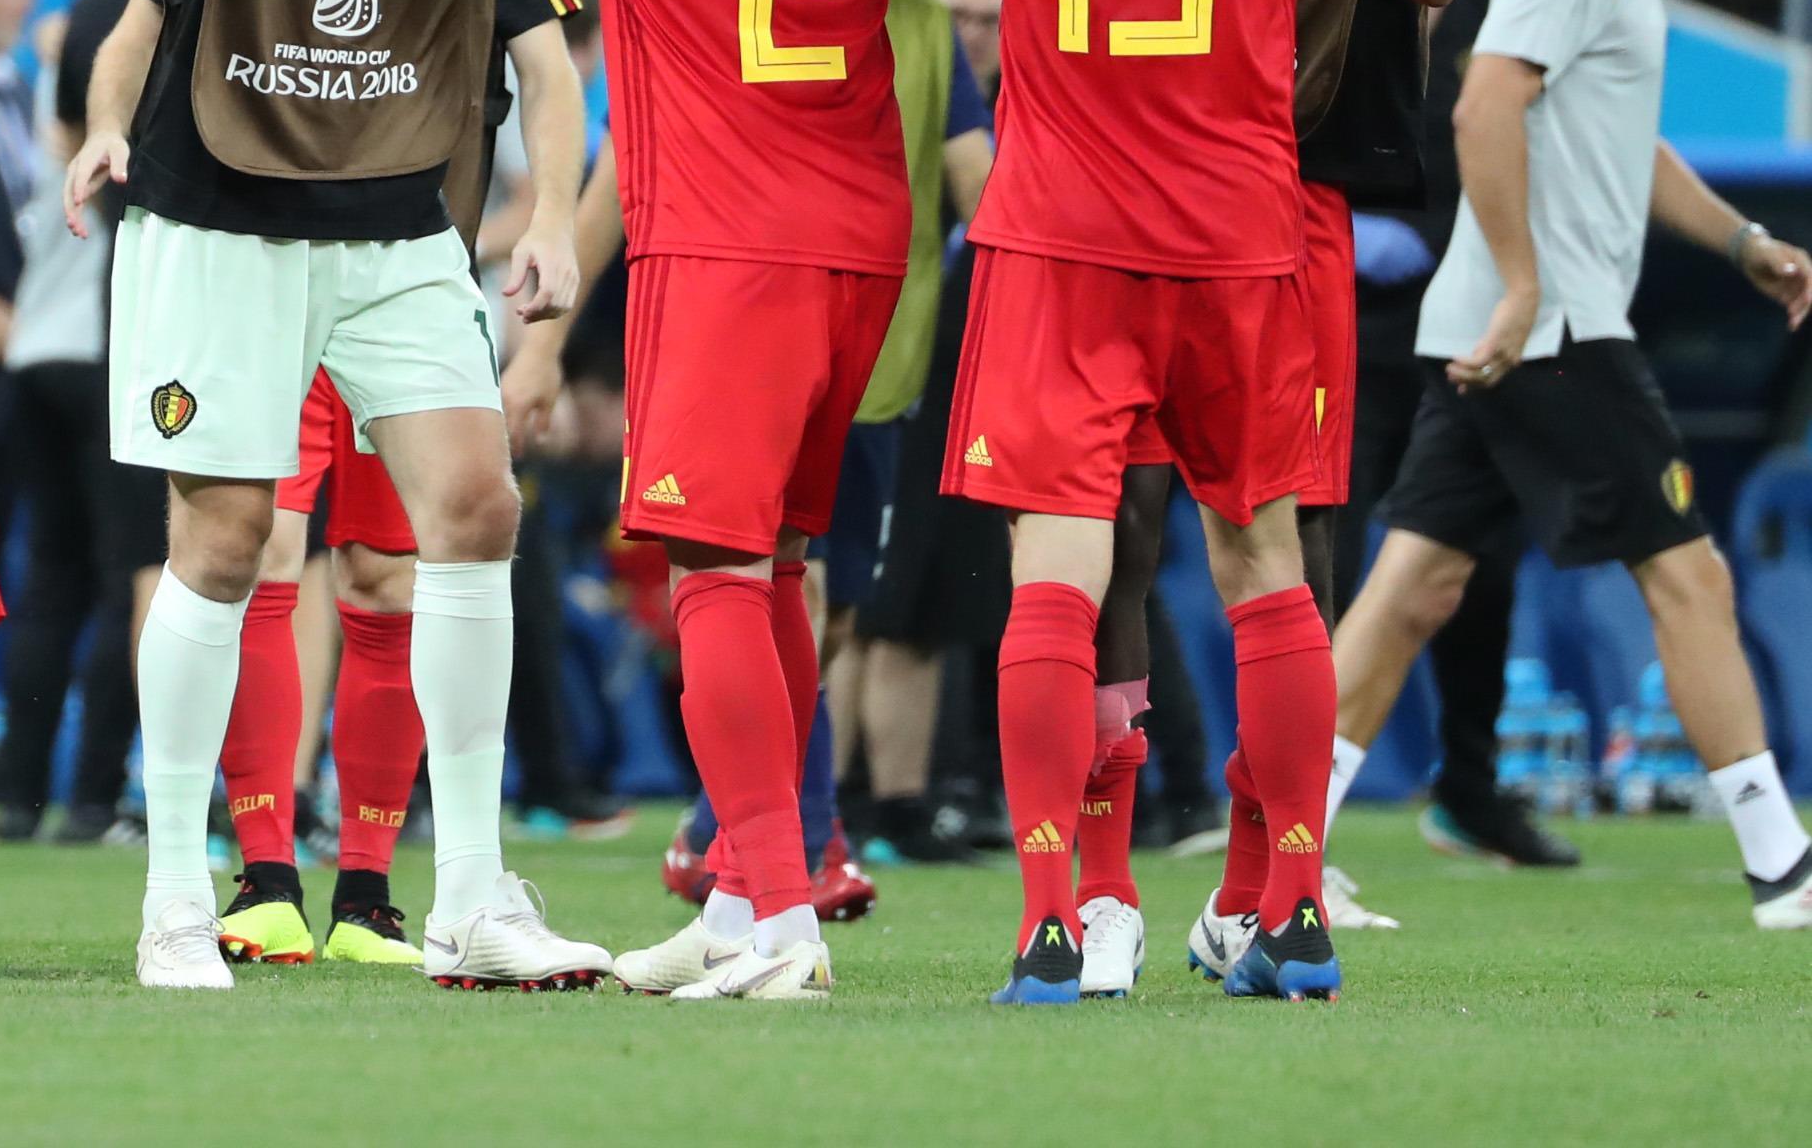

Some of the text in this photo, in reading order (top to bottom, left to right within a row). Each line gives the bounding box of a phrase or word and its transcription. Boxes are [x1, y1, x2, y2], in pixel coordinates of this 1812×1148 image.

[274, 43, 391, 65] FIFA WORLD CUP
[225, 53, 419, 100] RUSSIA 2018
[474, 308, 500, 388] 1
[964, 453, 993, 467] adidas
[642, 491, 687, 506] adidas
[1022, 840, 1066, 853] adidas
[1276, 840, 1319, 853] adidas
